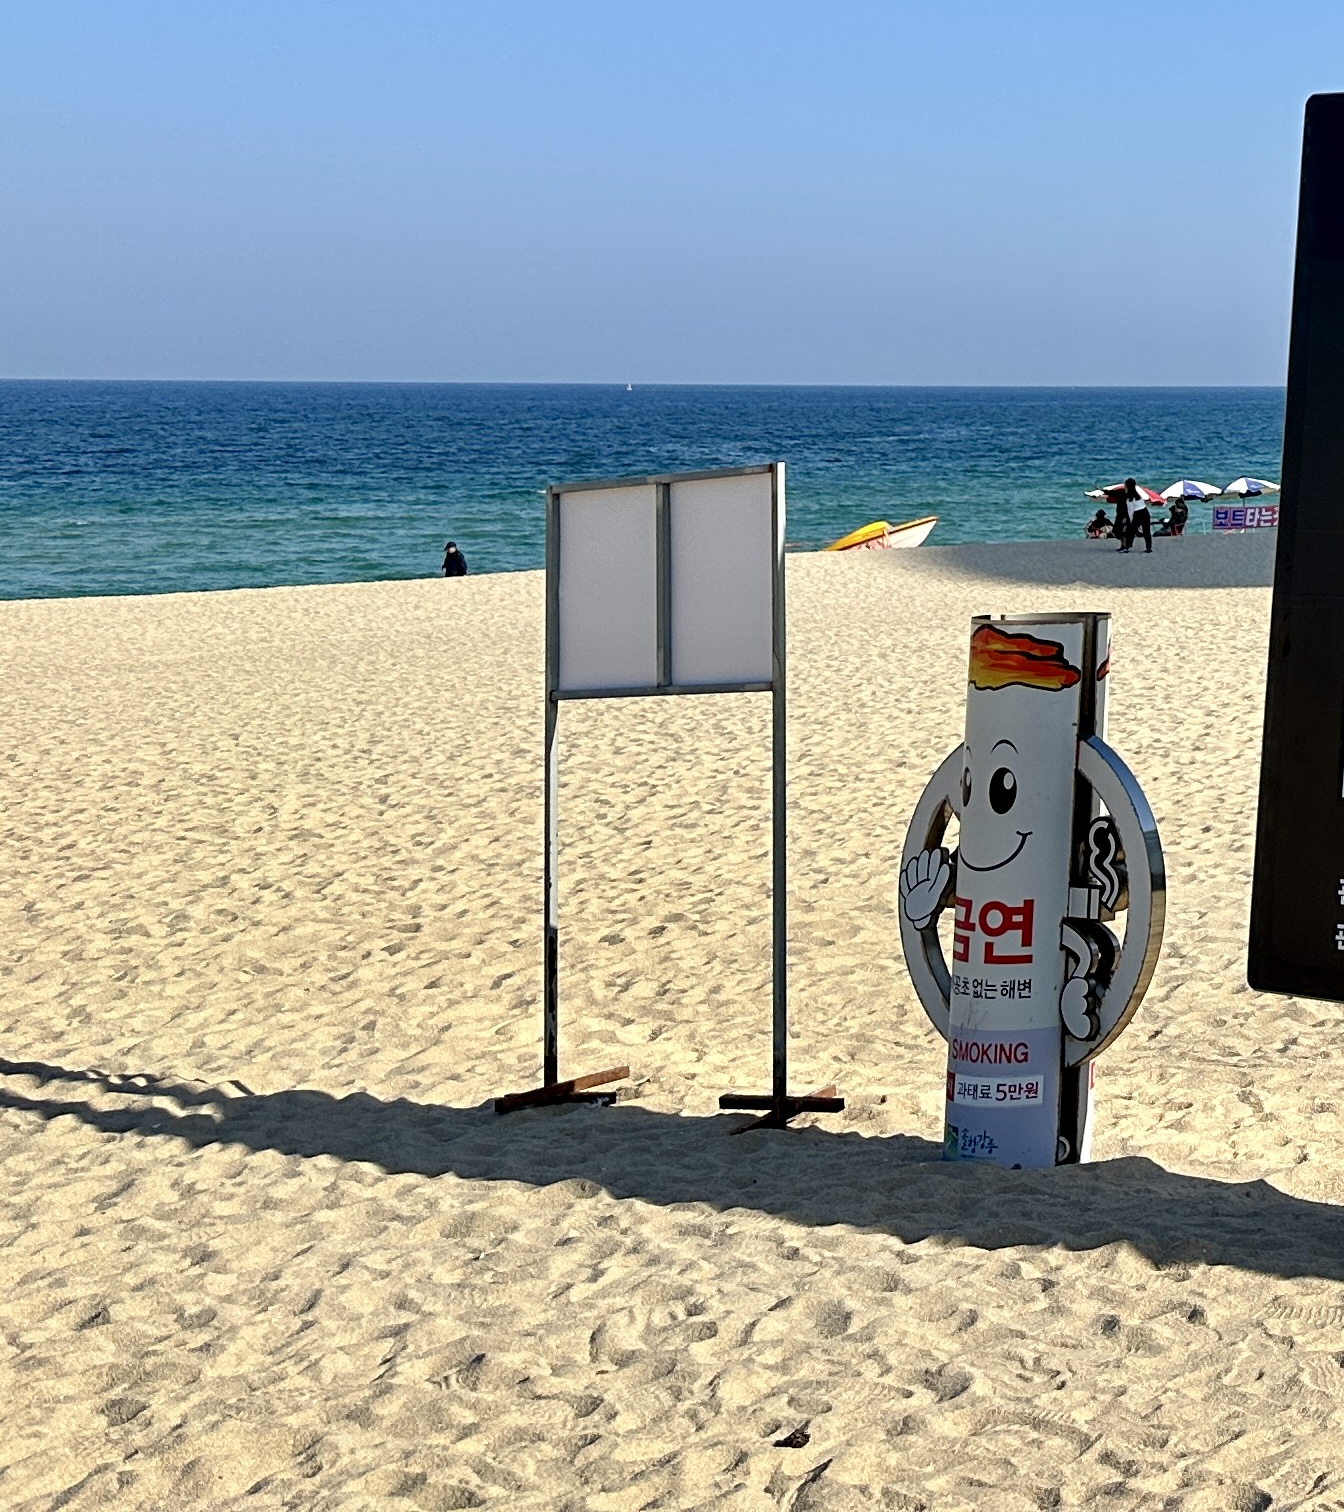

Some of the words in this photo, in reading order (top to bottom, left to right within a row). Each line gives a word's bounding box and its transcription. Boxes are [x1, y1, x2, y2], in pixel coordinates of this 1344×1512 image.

[972, 978, 998, 1000] 없는
[1000, 978, 1032, 1000] 해변
[952, 1038, 1029, 1064] SMOKING
[957, 1081, 993, 1100] 과태료
[995, 1081, 1039, 1101] 5만원
